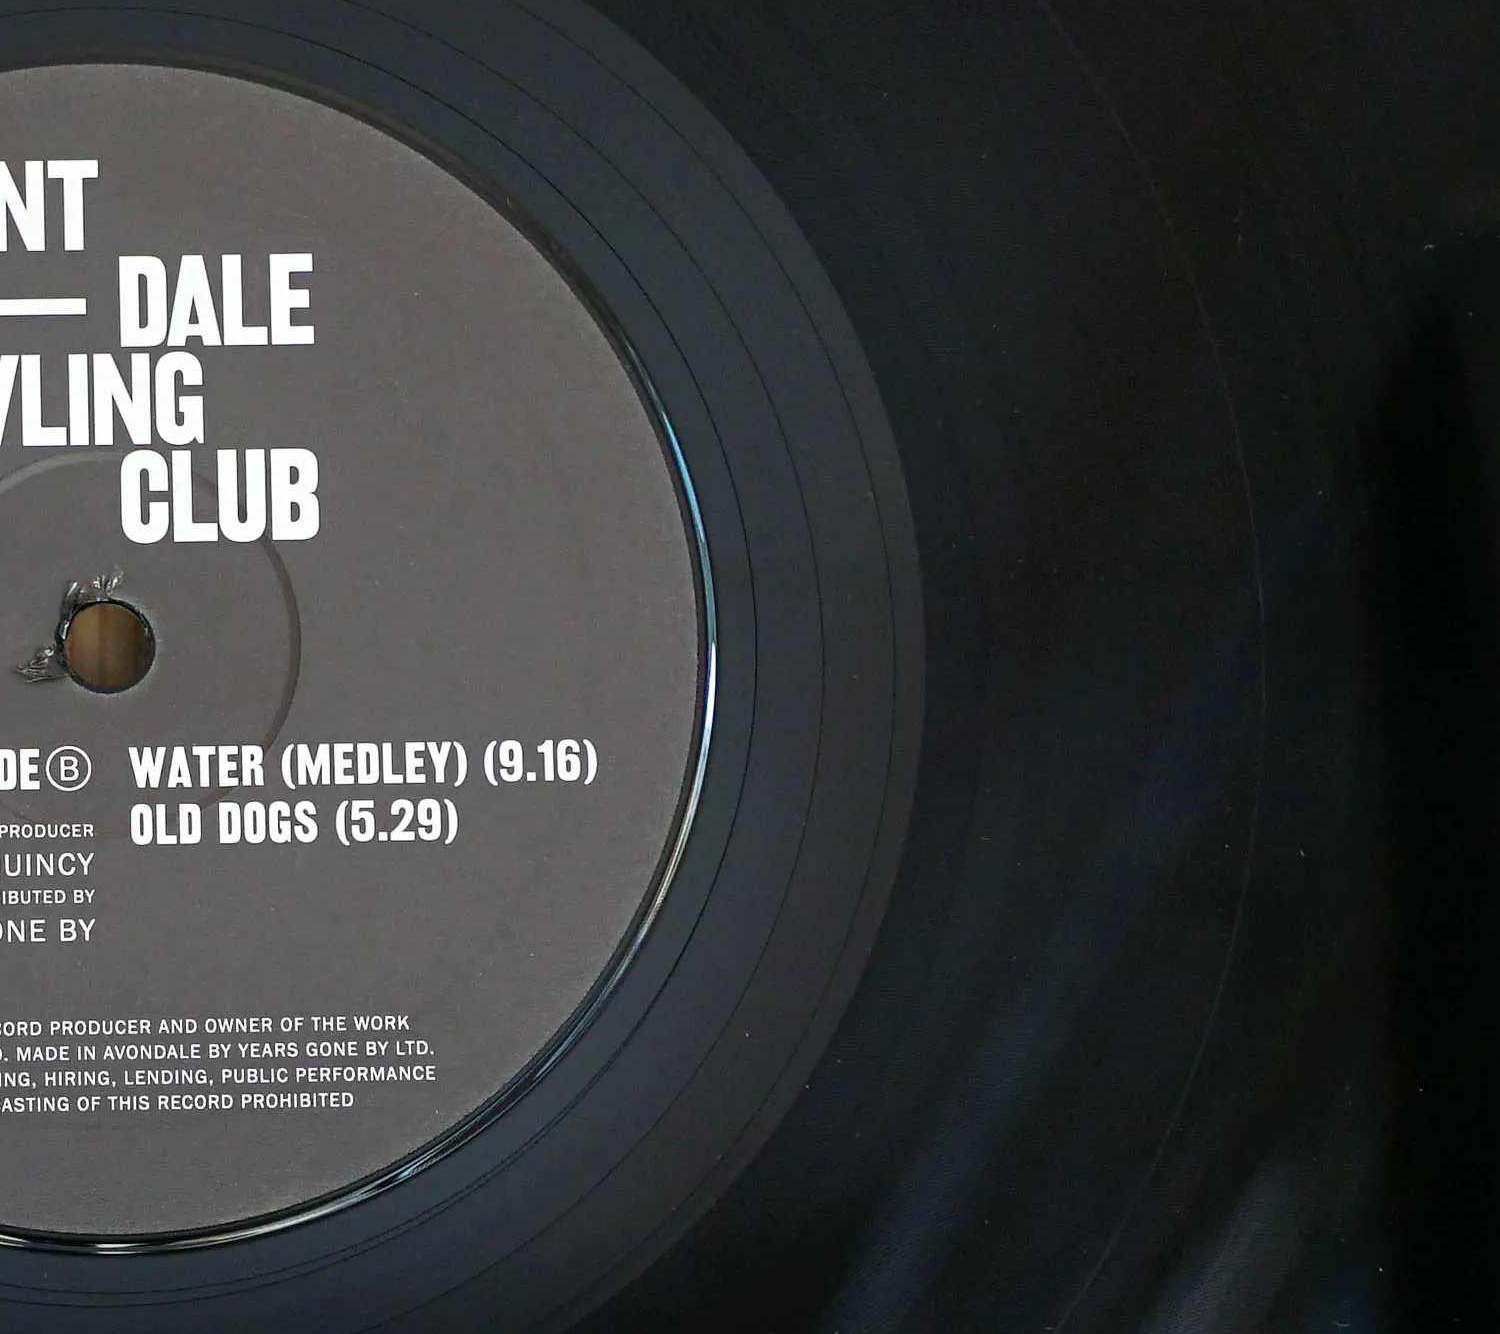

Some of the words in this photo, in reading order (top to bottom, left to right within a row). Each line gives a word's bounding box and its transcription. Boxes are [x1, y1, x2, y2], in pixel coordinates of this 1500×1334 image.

[118, 252, 315, 348] DALE
[120, 447, 320, 545] CLUB
[127, 743, 265, 789] WATER
[281, 740, 468, 790] (MEDLEY)
[483, 738, 598, 787] (9.16)
[130, 803, 202, 846] OLD
[218, 800, 319, 844] DOGS
[335, 798, 459, 847] (5.29)
[73, 888, 96, 904] BY
[59, 918, 96, 942] BY
[50, 1019, 151, 1036] PRODUCER
[158, 1018, 198, 1035] AND
[204, 1017, 273, 1034] OWNER
[280, 1016, 305, 1033] OF
[310, 1016, 347, 1032] THE
[353, 1014, 410, 1031] WORK
[16, 1045, 70, 1062] MADE
[77, 1045, 96, 1061] IN
[102, 1043, 202, 1061] AVONDALE
[208, 1043, 232, 1059] BY
[237, 1041, 299, 1059] YEARS
[305, 1041, 359, 1057] GONE
[365, 1040, 390, 1056] BY
[396, 1040, 436, 1057] LTD.
[44, 1070, 117, 1088] HIRING,
[124, 1069, 214, 1087] LENDING,
[221, 1067, 289, 1084] PUBLIC
[295, 1065, 437, 1083] PERFORMANCE
[76, 1095, 101, 1112] OF
[107, 1095, 150, 1111] THIS
[157, 1093, 234, 1111] RECORD
[241, 1092, 354, 1109] PROHIBITED
